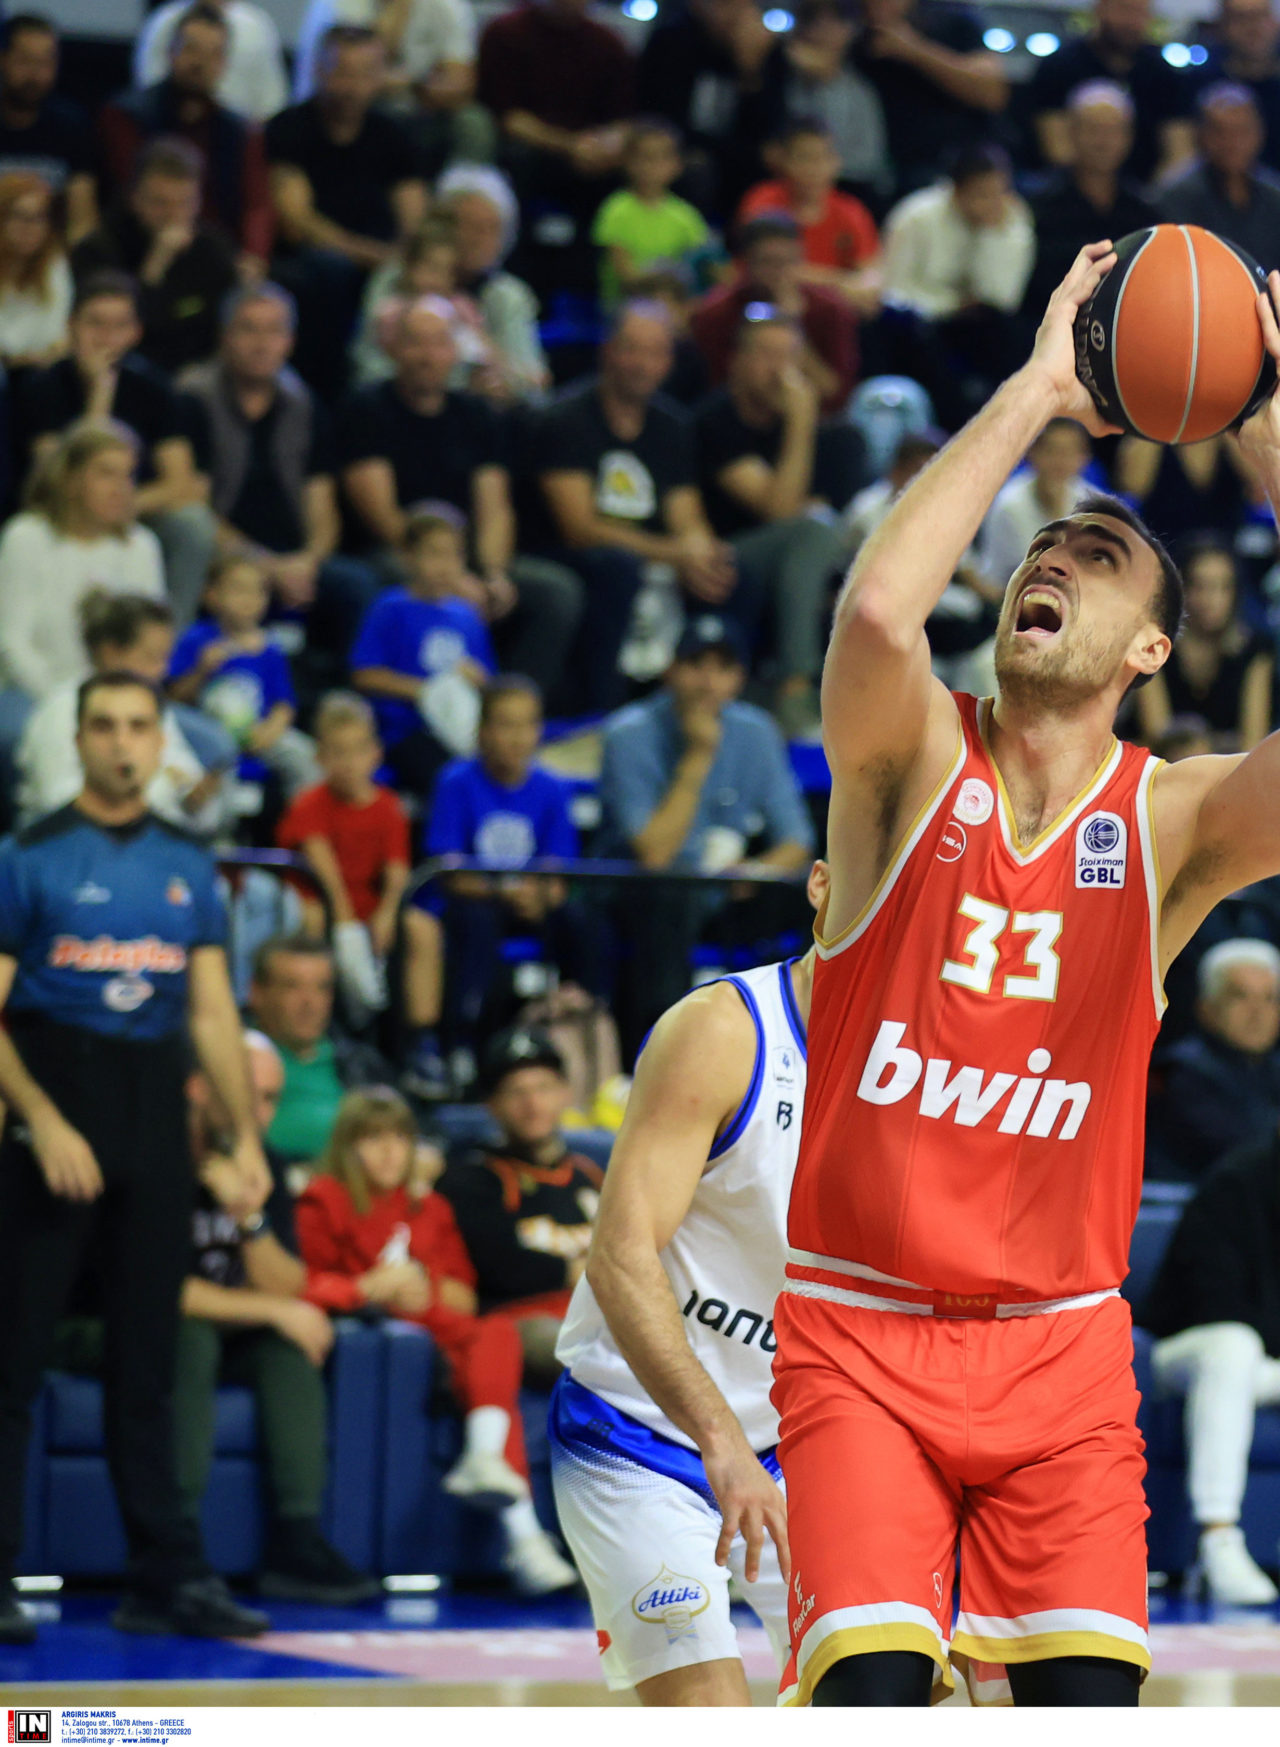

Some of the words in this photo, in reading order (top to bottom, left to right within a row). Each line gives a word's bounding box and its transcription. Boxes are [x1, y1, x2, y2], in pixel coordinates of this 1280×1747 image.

[1078, 857, 1125, 868] Stoiximan
[1080, 868, 1121, 884] GBL
[939, 893, 1064, 1002] 33
[857, 1020, 1092, 1141] bwin
[638, 1586, 702, 1612] Attiki
